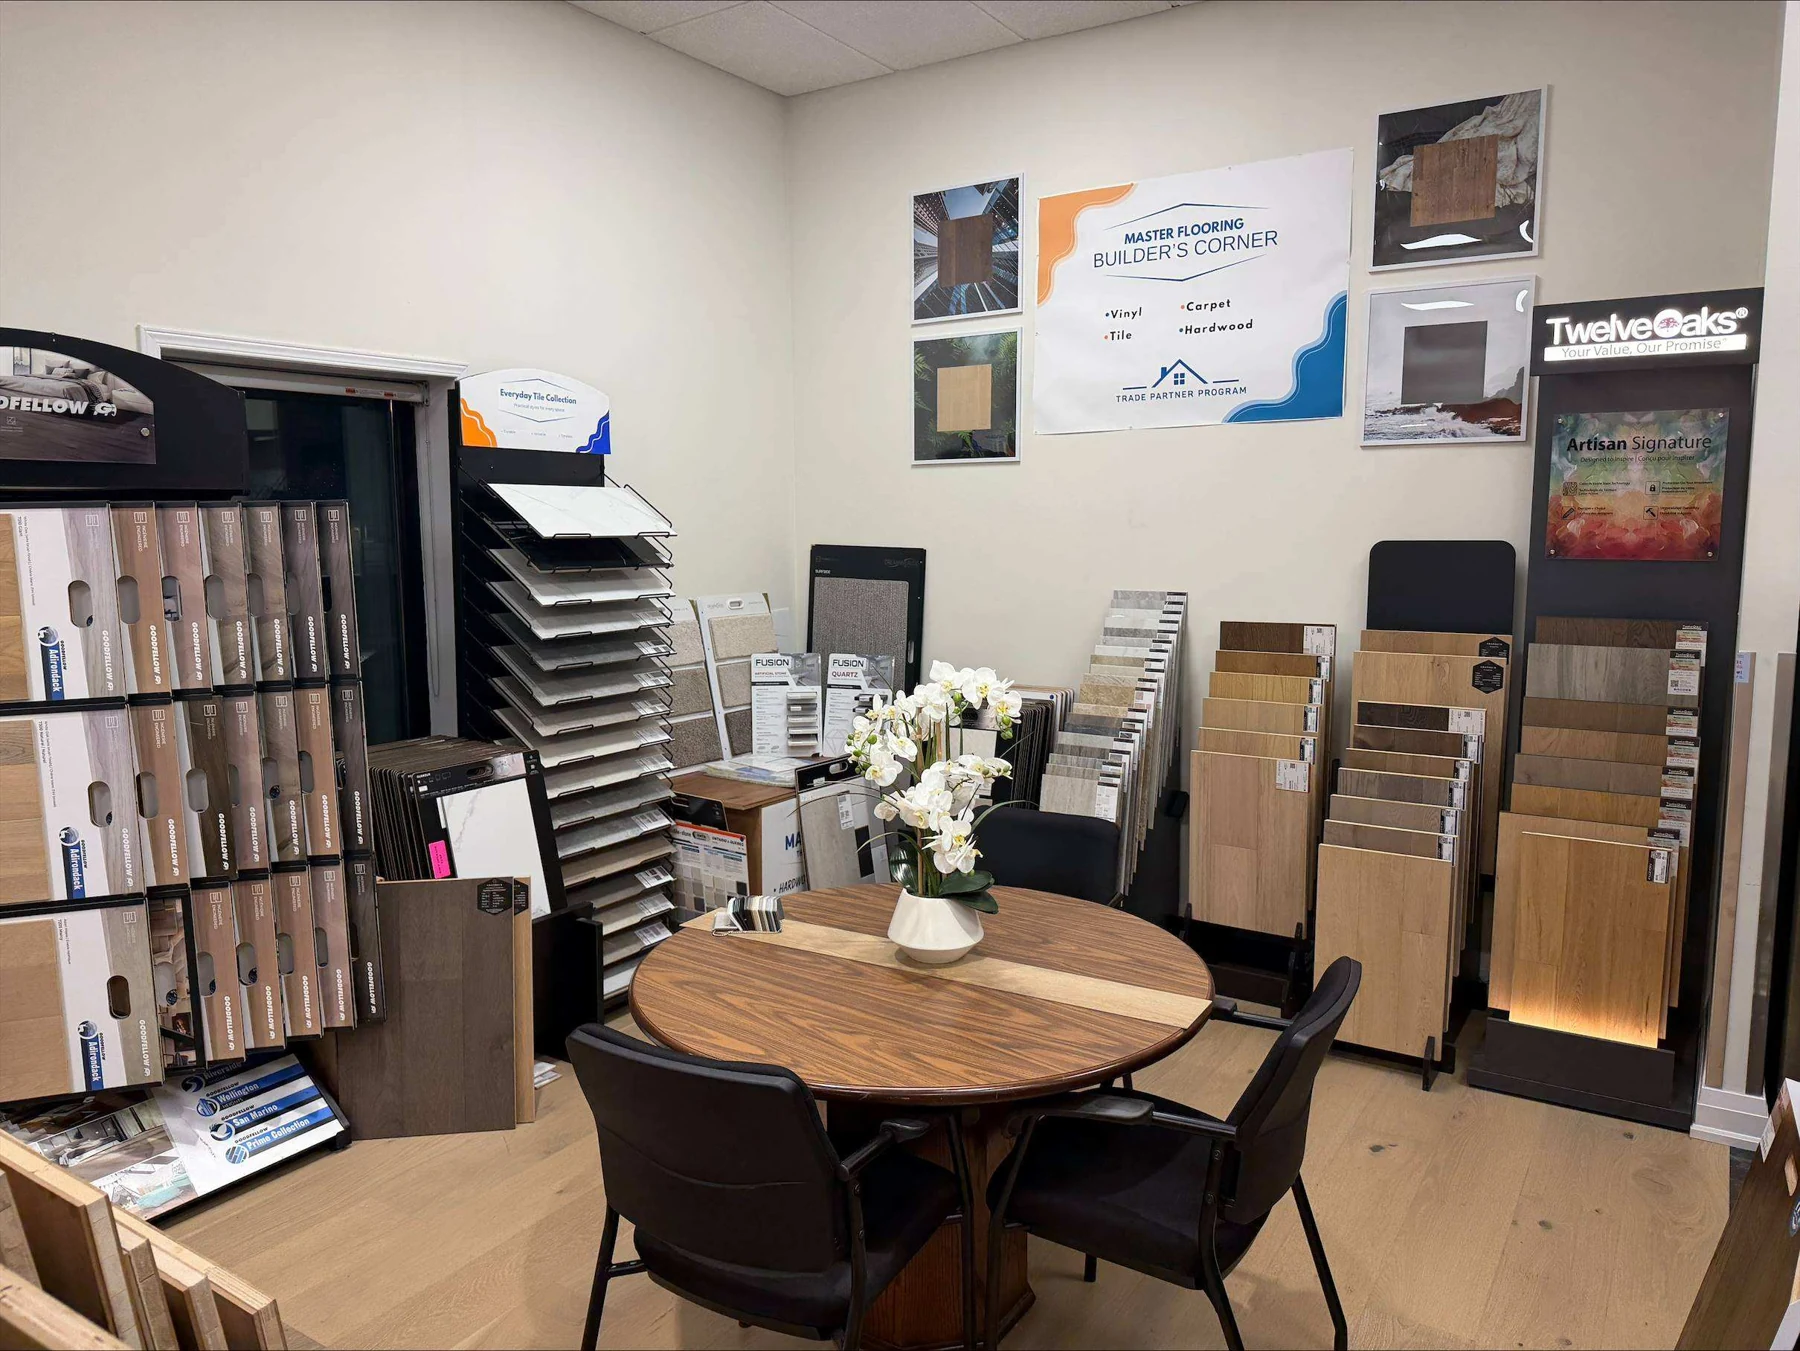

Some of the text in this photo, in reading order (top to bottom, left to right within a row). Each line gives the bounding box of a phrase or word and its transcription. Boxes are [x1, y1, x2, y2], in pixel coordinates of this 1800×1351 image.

[1093, 230, 1279, 268] BUILDER'S CORNER
[1124, 217, 1245, 245] MASTER FLOORING
[1110, 307, 1142, 319] Vinyl
[1186, 299, 1232, 313] Carpet
[1110, 330, 1133, 341] Tile
[1184, 319, 1254, 336] Hardwood
[1562, 347, 1590, 359] Your
[1594, 345, 1632, 357] Value,
[1637, 343, 1661, 354] Our
[500, 388, 577, 404] Everyday Tile Collection
[1115, 386, 1247, 403] TRADE PARTNER PROGRAM
[1566, 435, 1712, 453] Artisan Signature
[1580, 456, 1606, 464] Designed
[103, 630, 113, 682] GOODFELLOW
[150, 624, 161, 675] GOODFELLOW
[192, 622, 202, 671] GOODFELLOW
[236, 620, 247, 670] GOODFELLOW
[274, 618, 284, 667] GOODFELLOW
[307, 615, 317, 663] GOODFELLOW
[340, 614, 350, 660] GOODFELLOW
[49, 649, 62, 692] Adirondack
[755, 659, 790, 667] FUSION
[832, 659, 864, 667] FUSION
[250, 806, 259, 853] GOODFELLOW
[289, 800, 299, 847] GOODFELLOW
[322, 794, 331, 841] GOODFELLOW
[354, 790, 363, 836] GOODFELLOW
[122, 828, 133, 877] GOODFELLOW
[168, 819, 179, 868] GOODFELLOW
[218, 812, 229, 862] GOODFELLOW
[69, 848, 83, 890] Adirondack
[302, 975, 312, 1021] GOODFELLOW
[336, 969, 345, 1013] GOODFELLOW
[367, 961, 376, 1006] GOODFELLOW
[224, 996, 235, 1042] GOODFELLOW
[265, 985, 275, 1031] GOODFELLOW
[88, 1041, 100, 1082] Adirondack
[139, 1020, 150, 1067] GOODFELLOW
[206, 1081, 240, 1097] GOODFELLOW
[217, 1083, 260, 1103] Wellington
[221, 1104, 255, 1121] GOODFELLOW
[233, 1104, 278, 1127] San Marino
[234, 1127, 268, 1144] GOODFELLOW
[246, 1117, 310, 1151] Prime Collection
